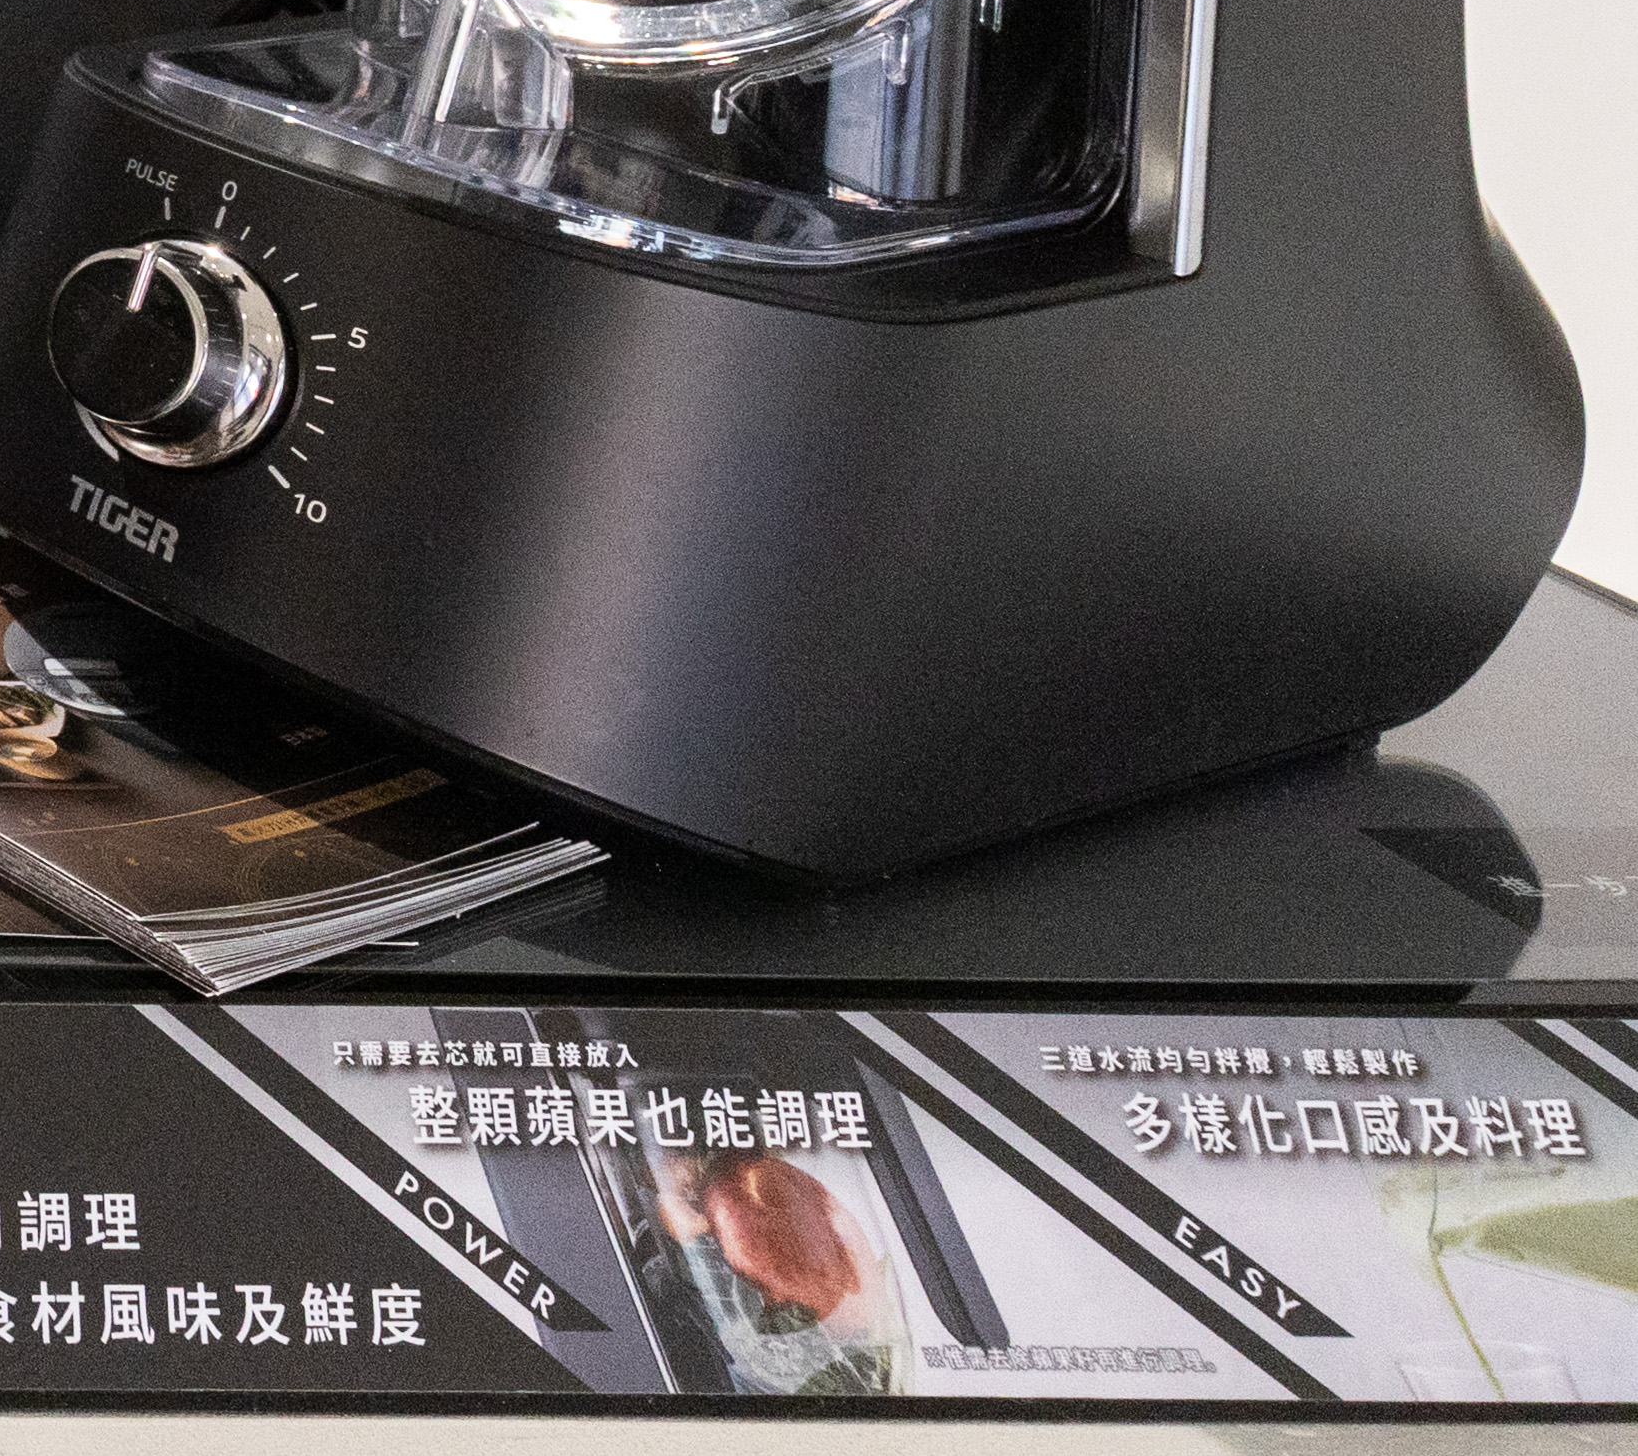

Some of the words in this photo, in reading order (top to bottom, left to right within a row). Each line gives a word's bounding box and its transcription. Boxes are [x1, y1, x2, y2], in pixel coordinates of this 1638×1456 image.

[125, 158, 179, 192] PULSE
[222, 181, 237, 201] 0
[348, 328, 368, 348] 5
[70, 474, 179, 562] TIGER
[294, 493, 327, 524] 10
[332, 1039, 639, 1070] 只需要去芯就可直接放入
[410, 1085, 873, 1151] 整顆蘋果也能調理
[1122, 1096, 1587, 1160] 多樣化口感及料理
[392, 1171, 559, 1320] POWER
[1174, 1217, 1300, 1321] EASY
